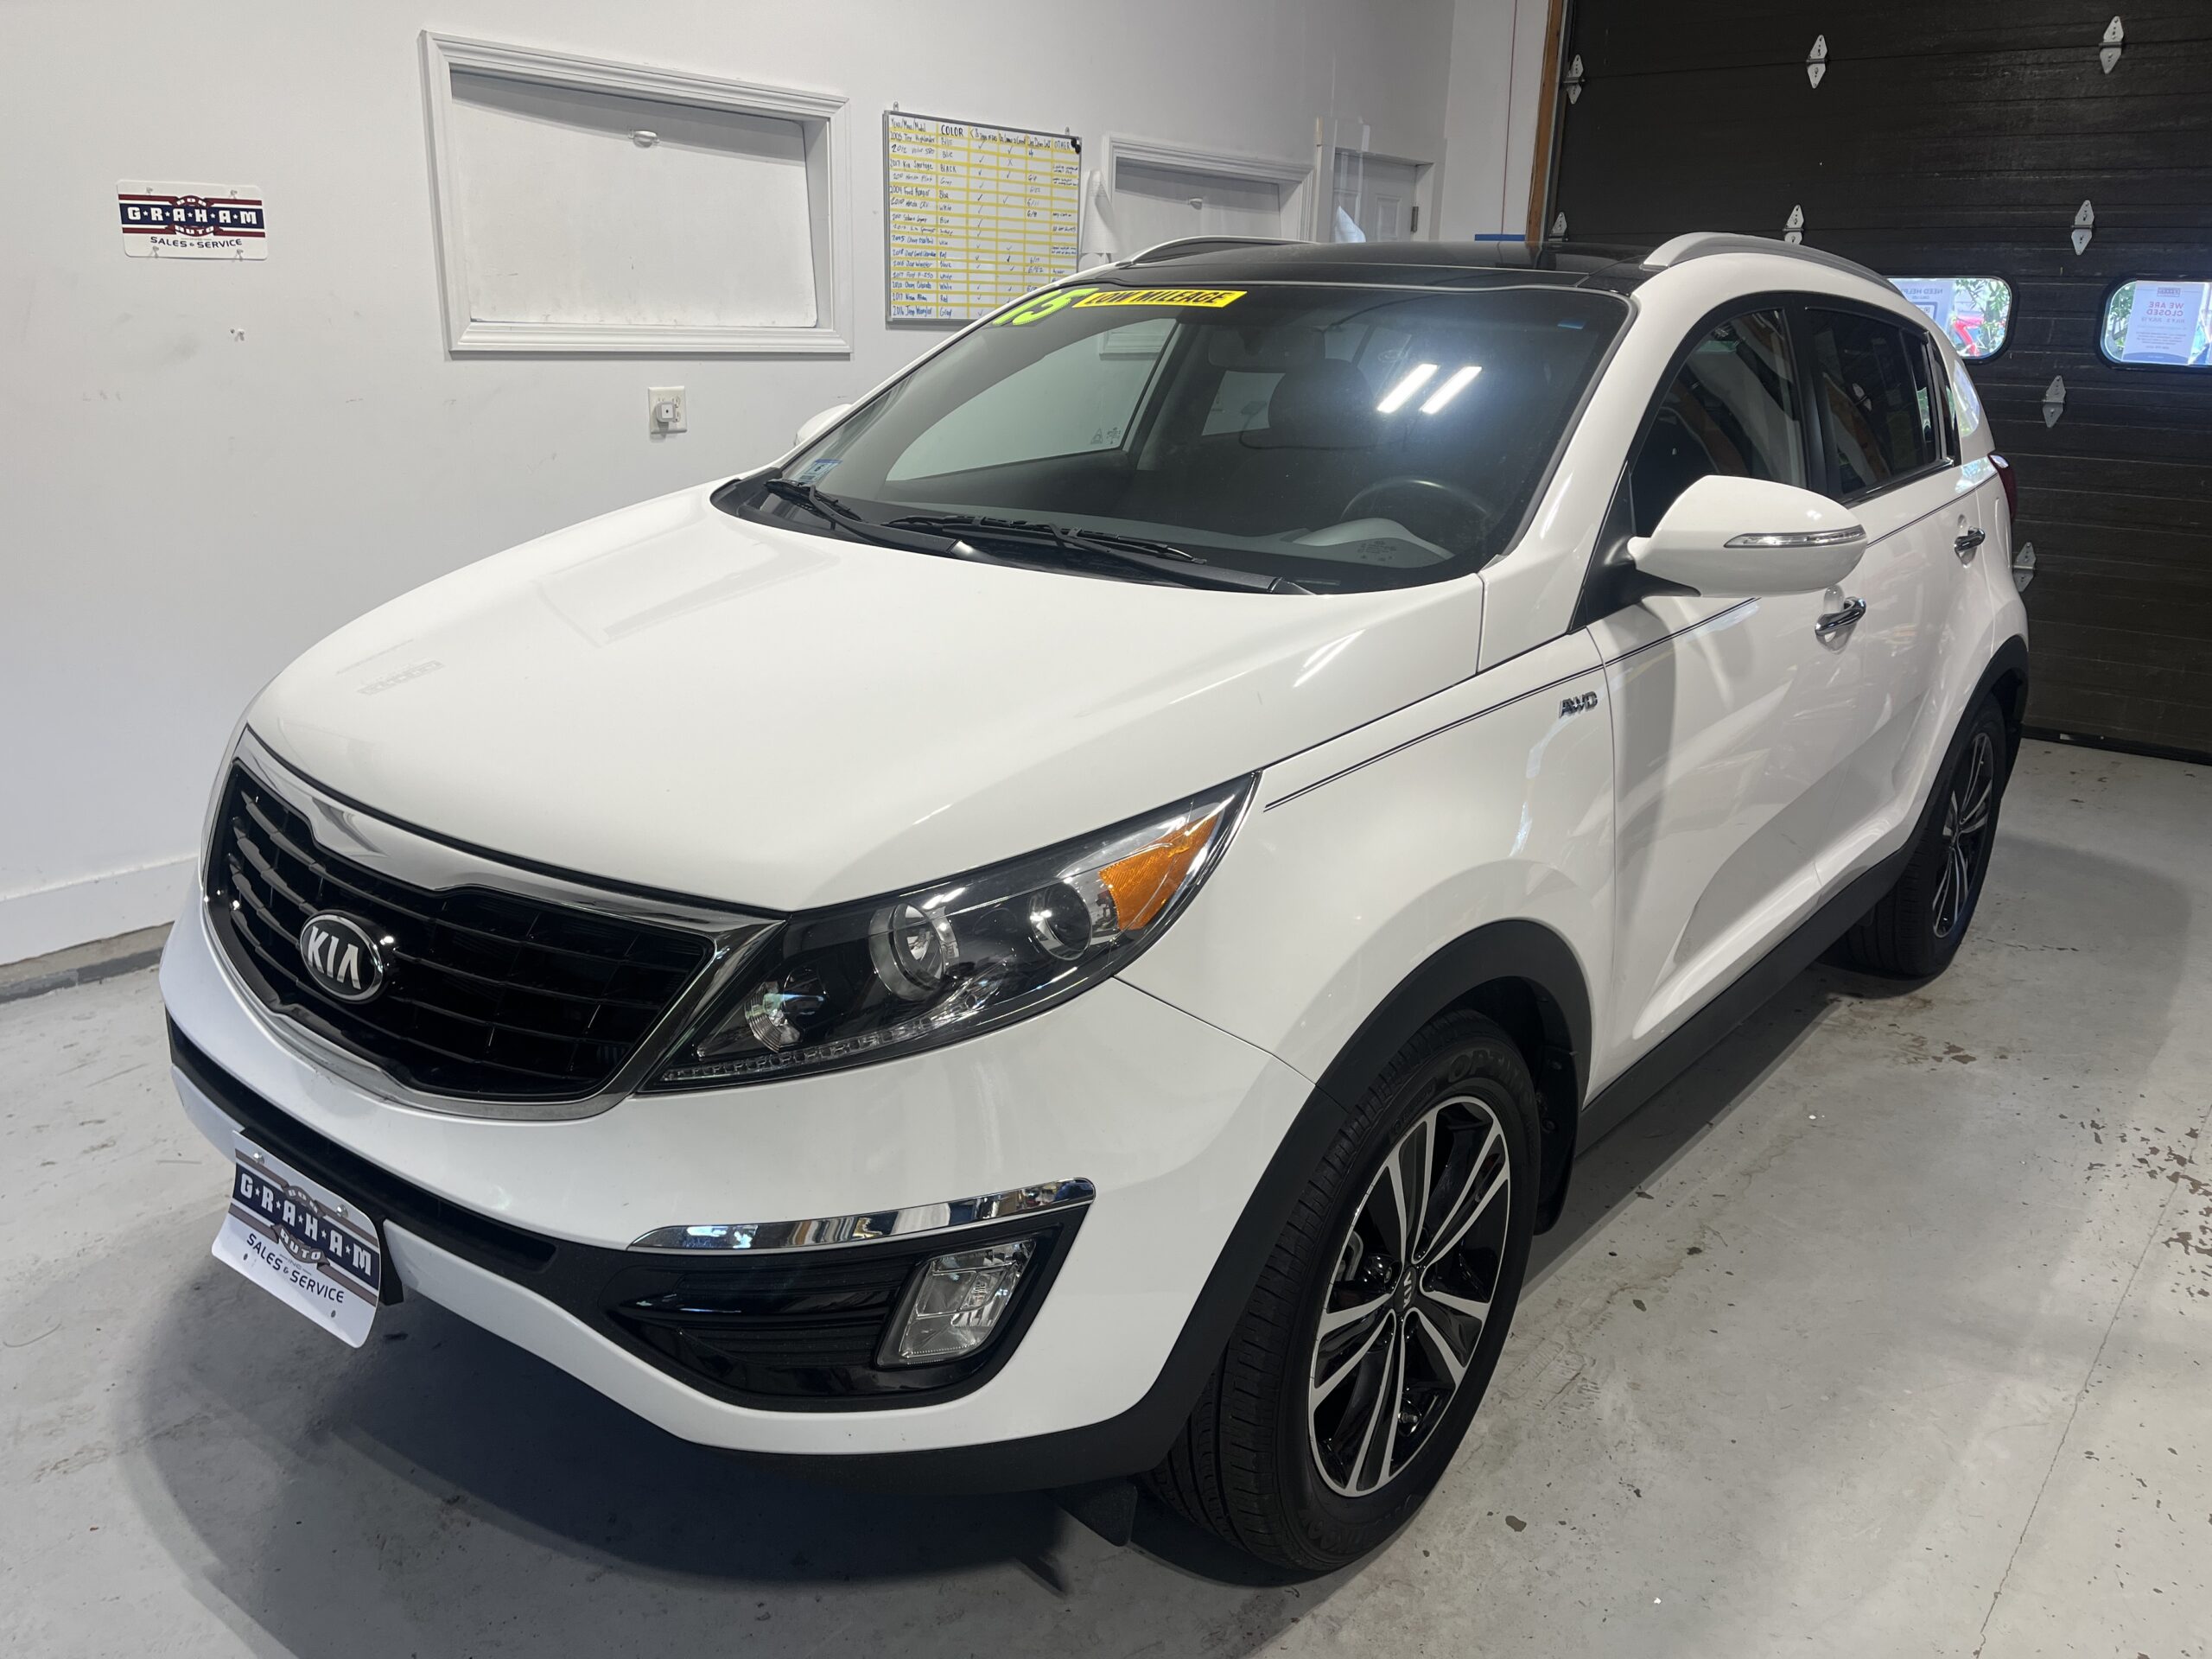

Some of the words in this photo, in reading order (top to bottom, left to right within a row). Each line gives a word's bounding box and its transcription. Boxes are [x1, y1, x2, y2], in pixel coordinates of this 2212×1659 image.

[941, 125, 963, 137] COLOR
[1054, 138, 1070, 149] OTHER
[175, 225, 214, 235] AUTO
[150, 236, 188, 248] SALES
[197, 238, 243, 249] SERVICE
[1084, 291, 1141, 304] LOW
[1134, 291, 1234, 303] MILEAGE
[1559, 691, 1598, 718] AWD
[308, 925, 361, 990] KIA
[280, 1228, 321, 1260] AUTO
[246, 1233, 283, 1271] SALES
[289, 1270, 345, 1304] SERVICE
